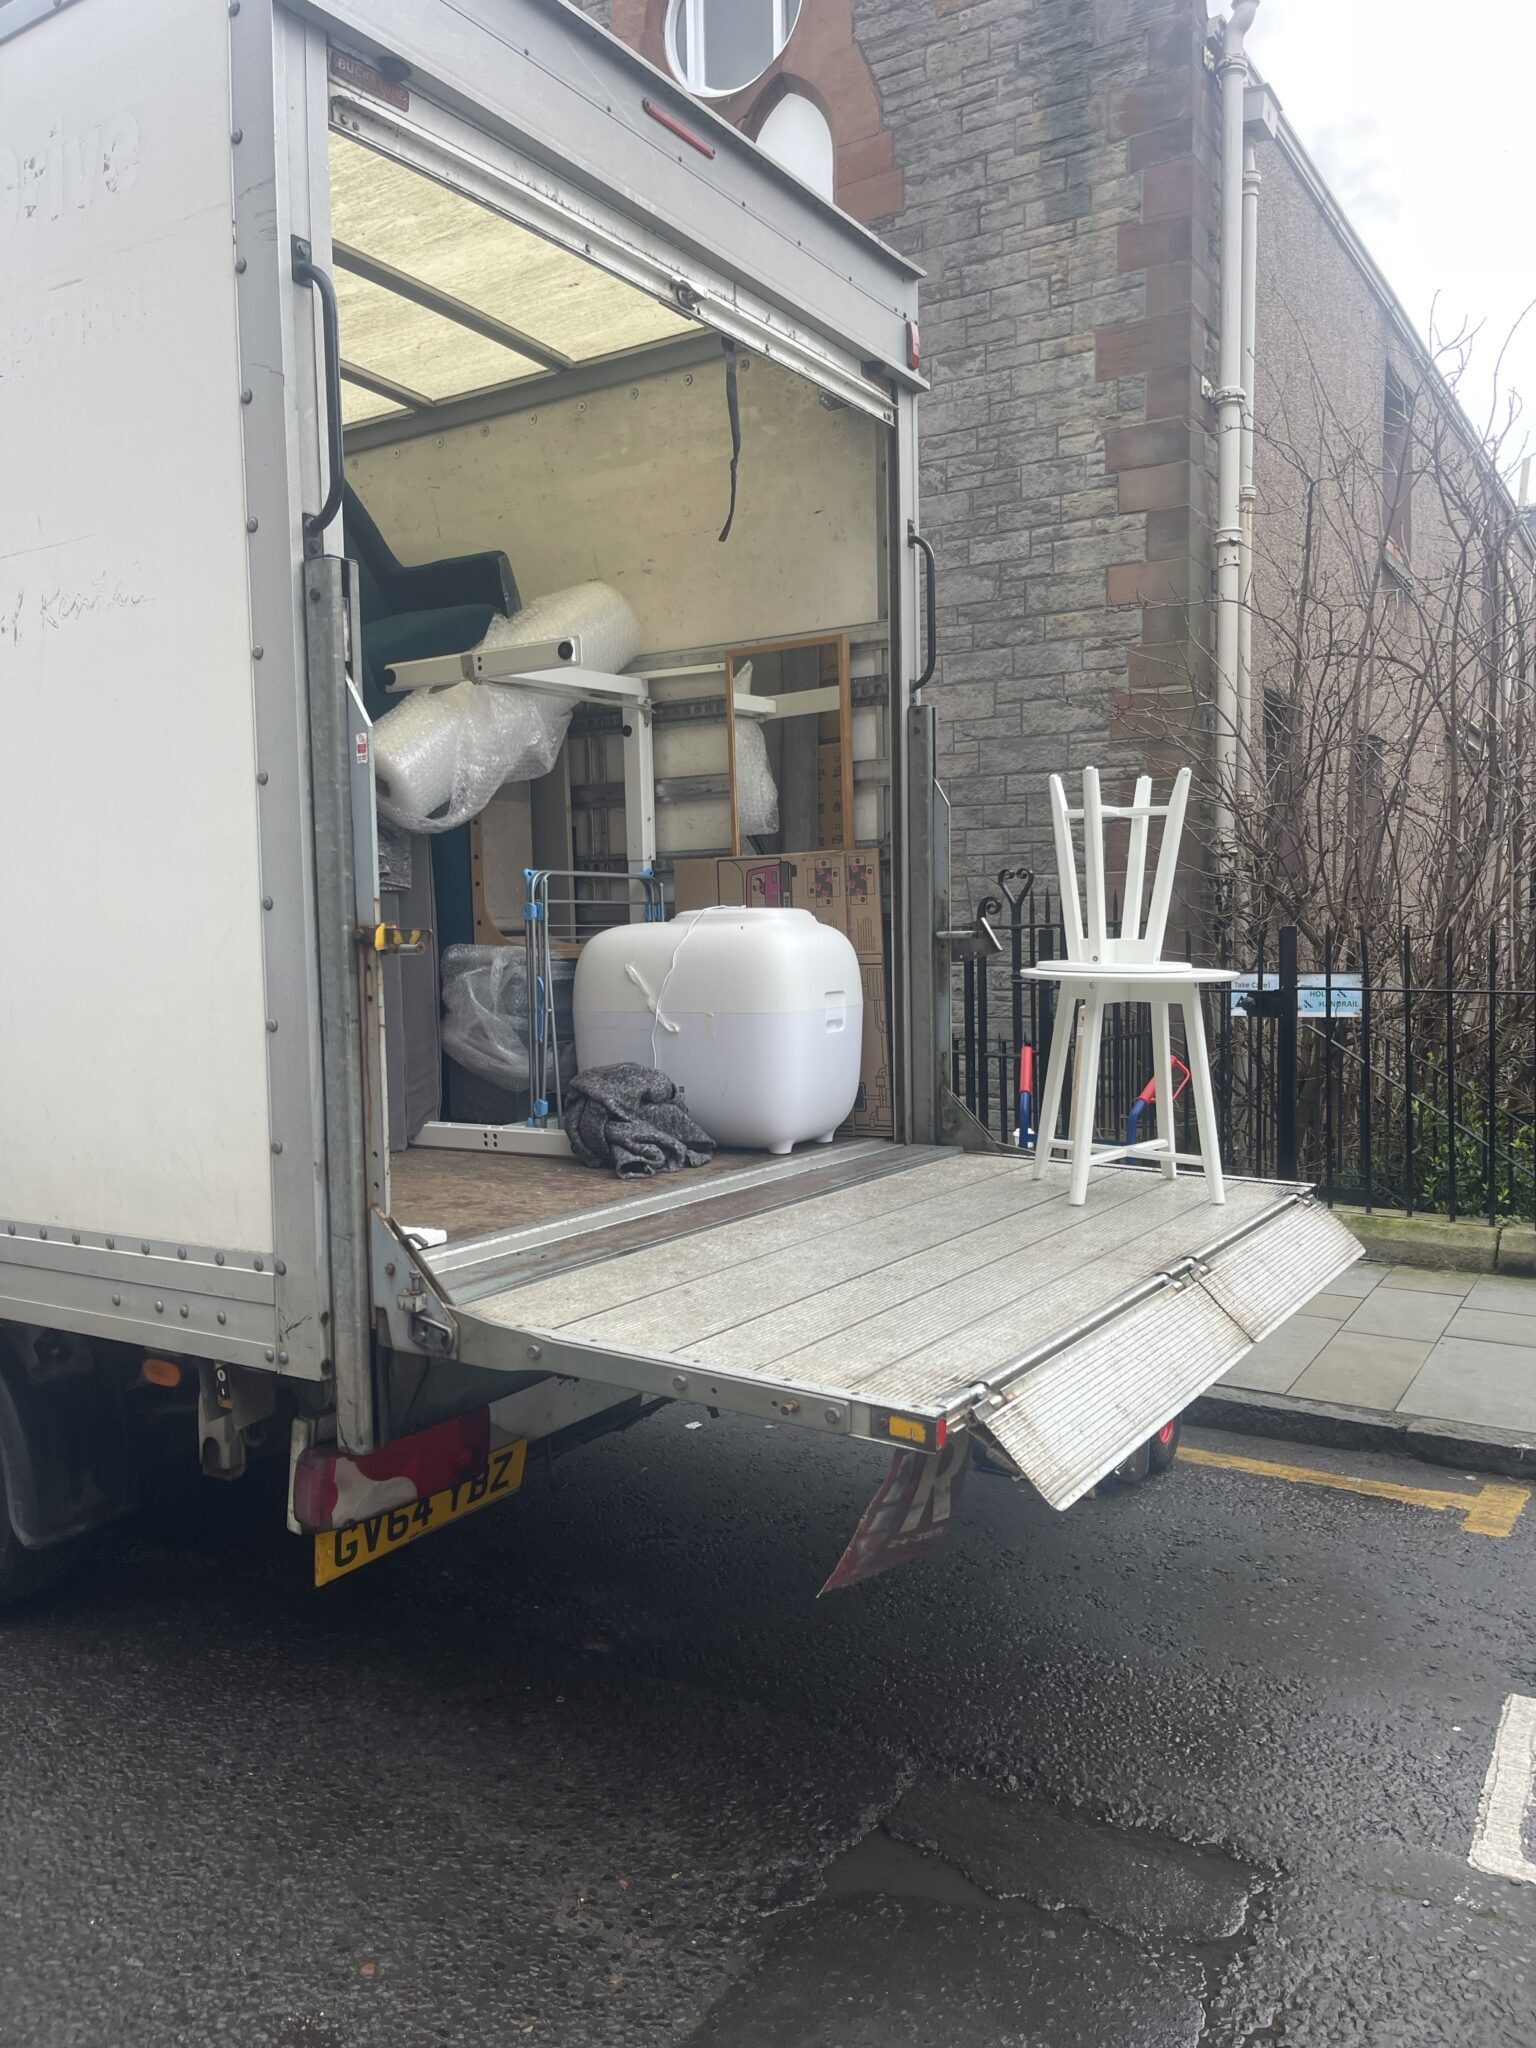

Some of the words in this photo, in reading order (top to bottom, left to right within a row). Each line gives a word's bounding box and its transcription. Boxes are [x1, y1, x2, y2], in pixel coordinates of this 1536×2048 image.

[1234, 981, 1250, 989] Take
[1251, 981, 1271, 989] Ce!
[1309, 990, 1327, 998] HOL
[1318, 1000, 1360, 1008] HNDRAIL
